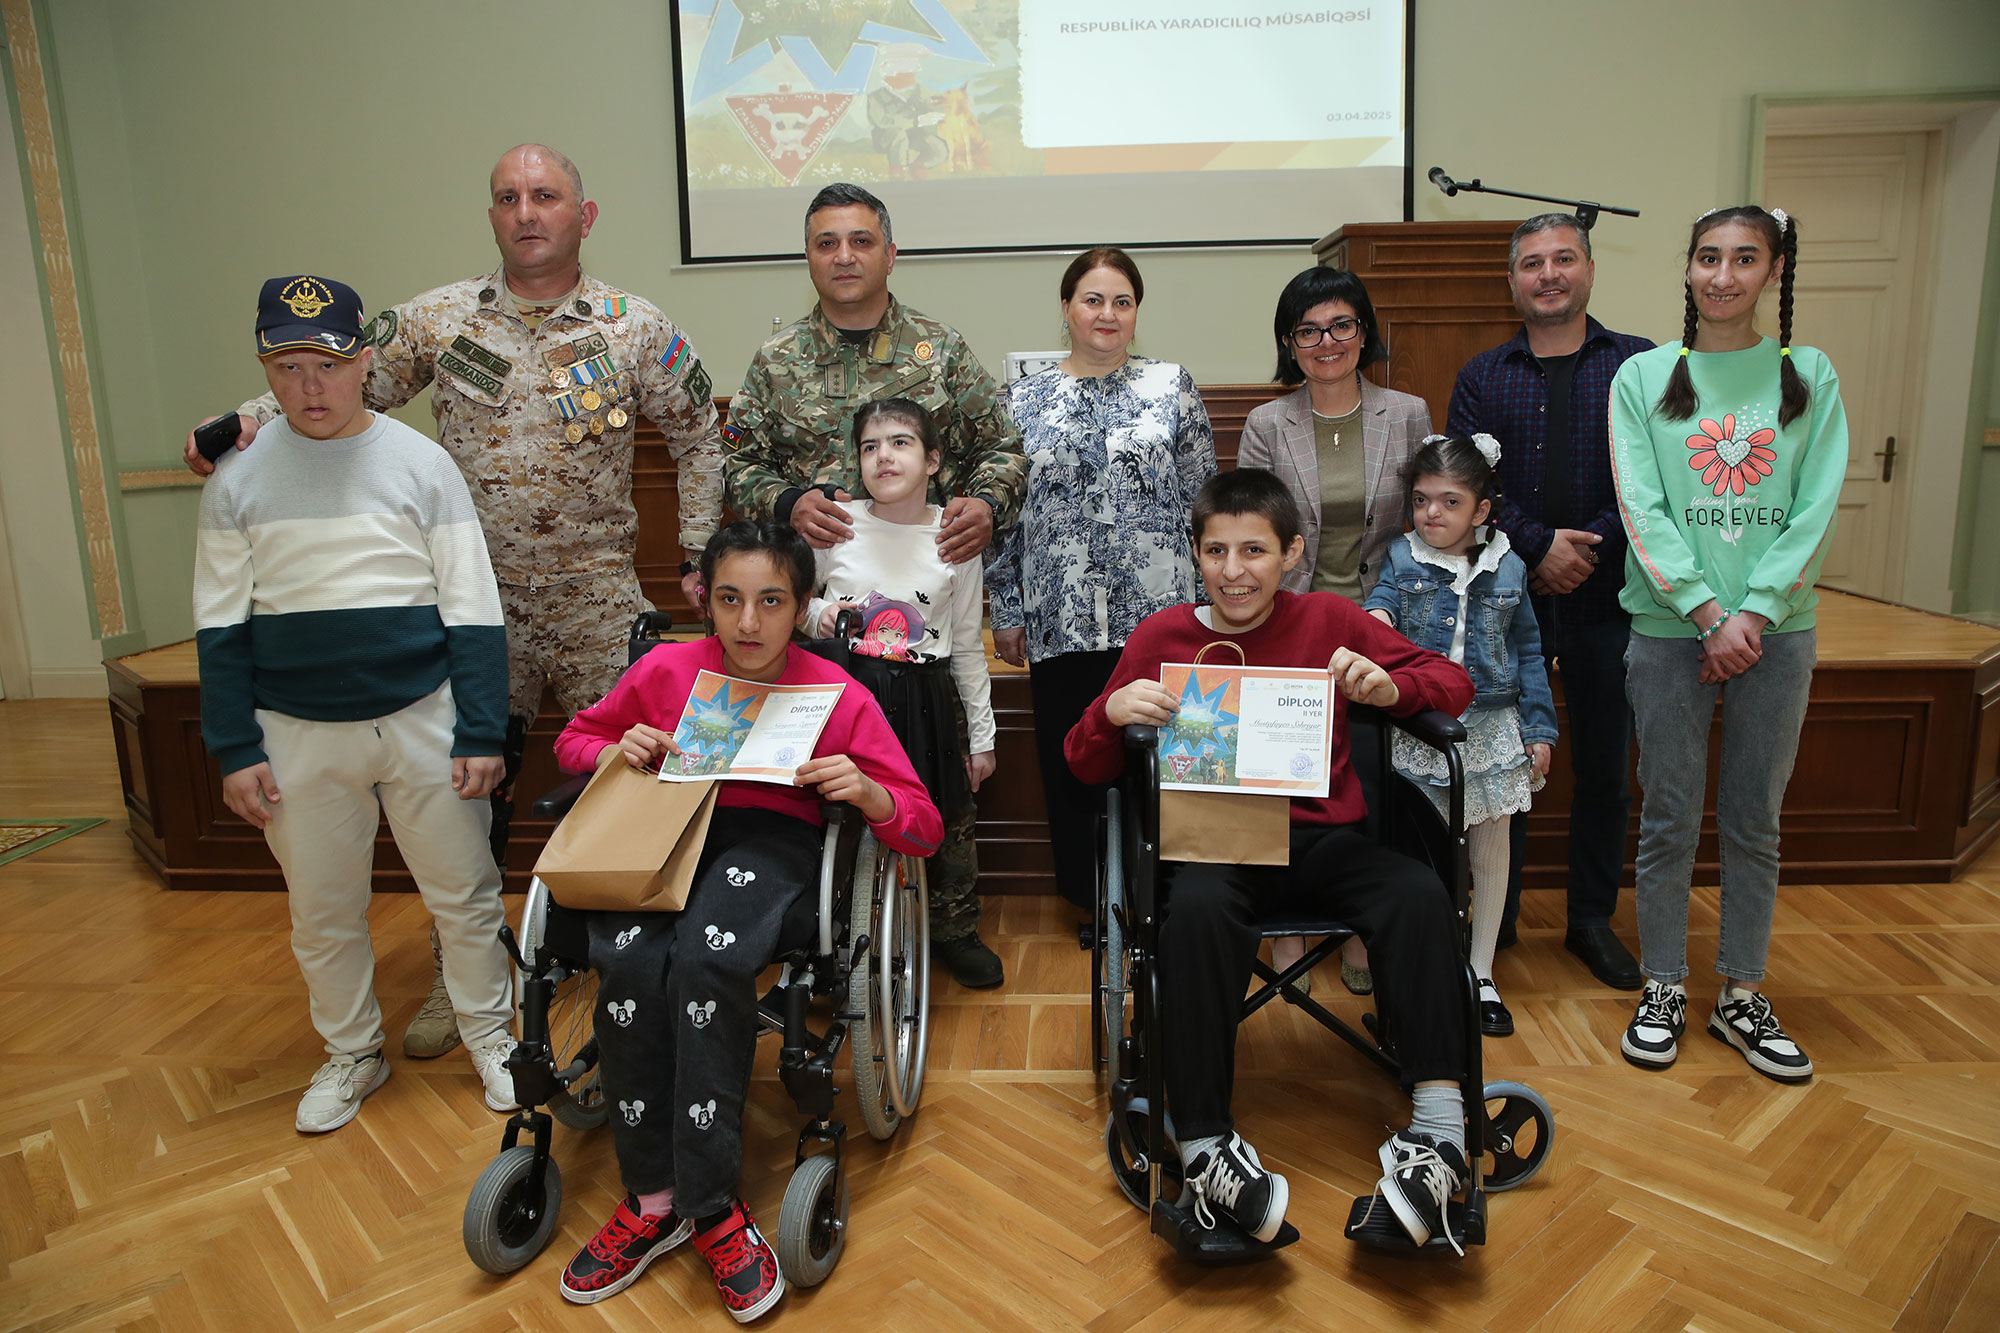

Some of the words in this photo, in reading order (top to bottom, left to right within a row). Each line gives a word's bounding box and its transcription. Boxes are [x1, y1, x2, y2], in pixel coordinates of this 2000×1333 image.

[1060, 18, 1157, 33] RESPUBLİKA
[1160, 16, 1262, 30] YARADICILIQ
[1265, 7, 1371, 26] MÜSABİQƏSİ
[1326, 111, 1392, 122] 03.04.2025
[444, 356, 496, 391] KOMANDO
[1690, 495, 1726, 508] feeling
[1734, 494, 1760, 507] good
[1277, 695, 1323, 708] DİPLOM
[790, 704, 828, 714] DİPLOM
